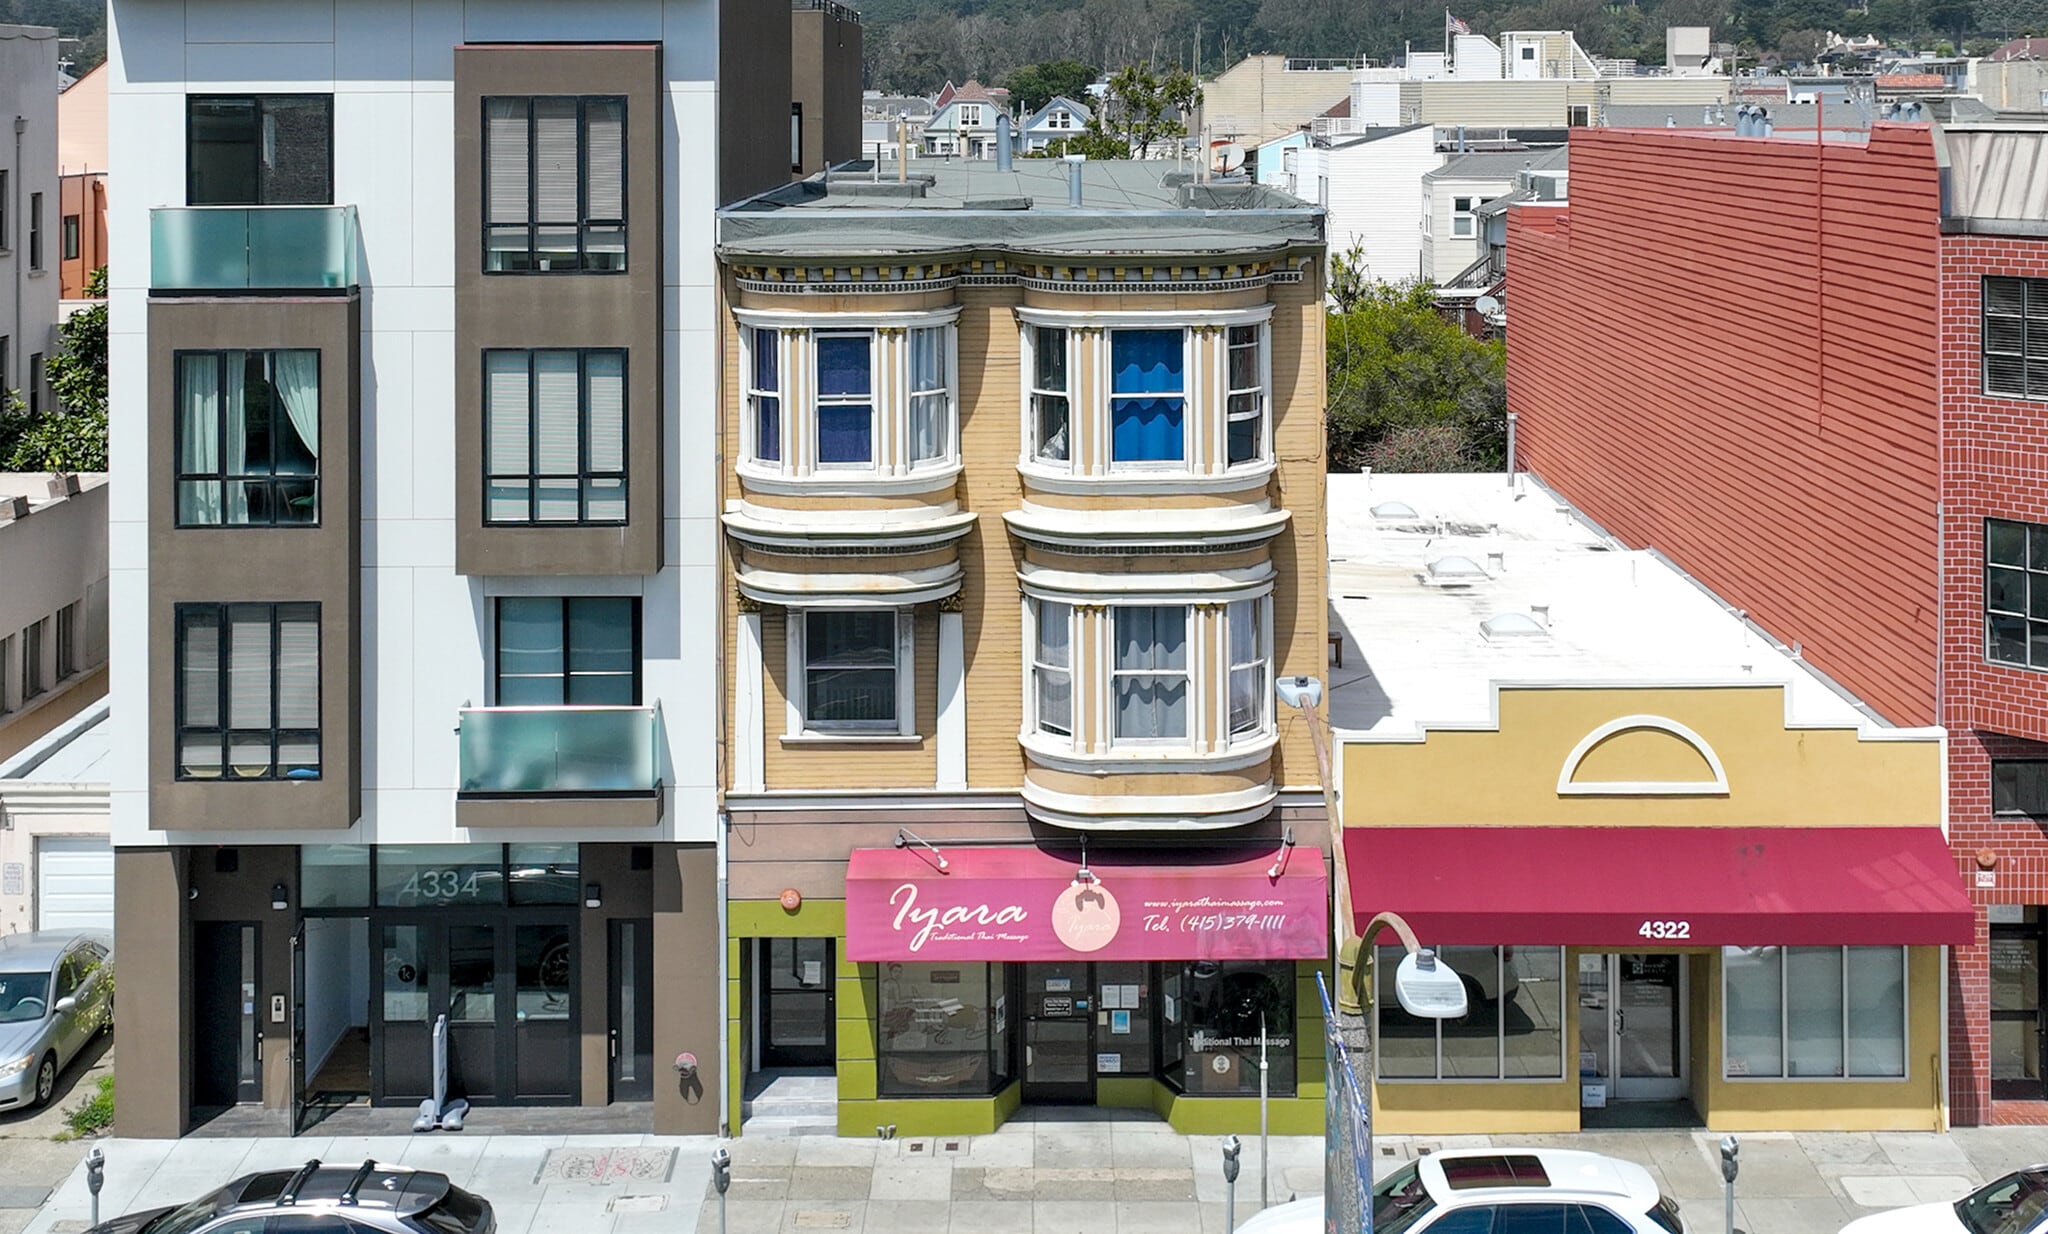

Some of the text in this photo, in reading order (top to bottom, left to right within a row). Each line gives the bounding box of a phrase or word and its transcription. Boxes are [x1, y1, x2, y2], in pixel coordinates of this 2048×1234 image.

[402, 870, 480, 898] 4334
[1144, 896, 1284, 913] www.iyarathaimassage.com
[890, 883, 1028, 952] Iyara
[1143, 914, 1170, 932] Tel.
[976, 931, 994, 940] Thai
[995, 933, 1030, 943] Massage
[1638, 920, 1691, 939] 4322
[1234, 1036, 1252, 1046] Thai
[1253, 1037, 1290, 1048] Mssage
